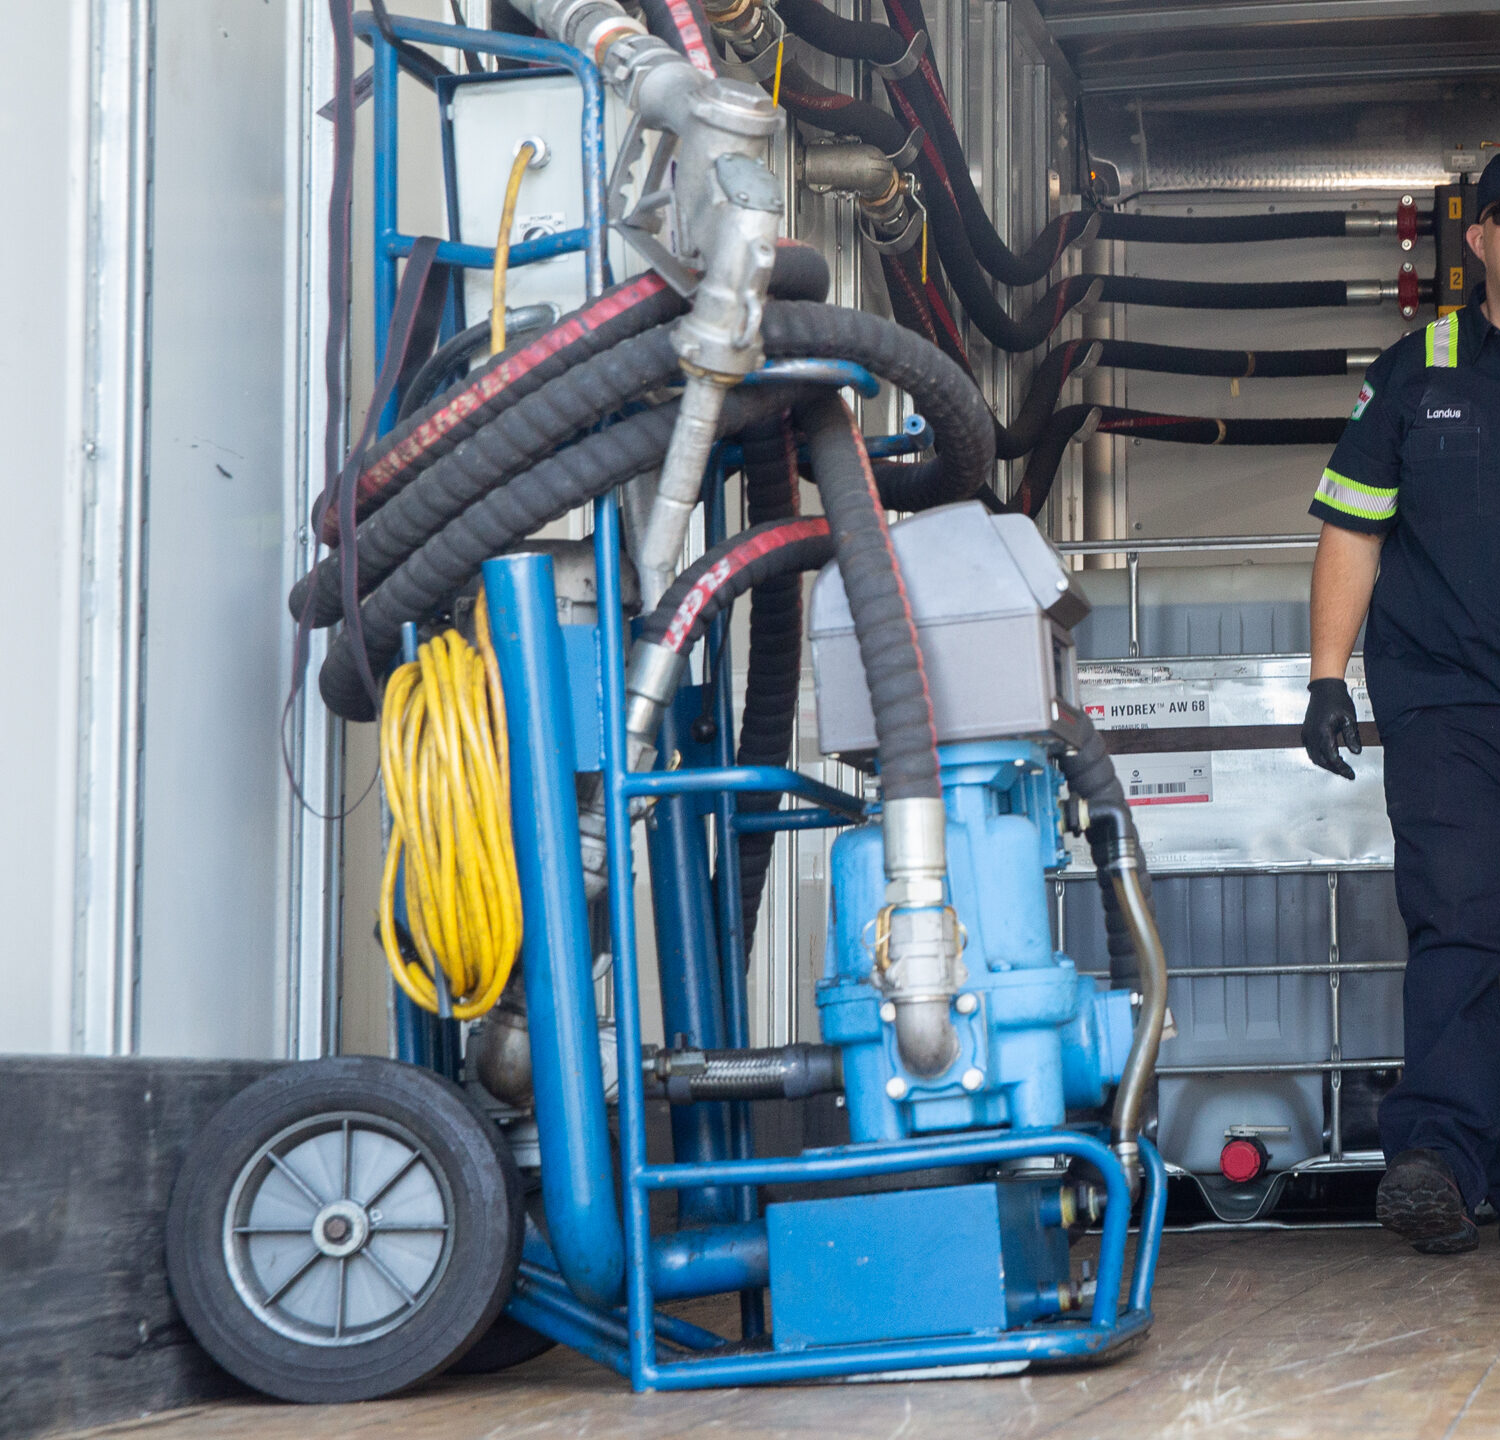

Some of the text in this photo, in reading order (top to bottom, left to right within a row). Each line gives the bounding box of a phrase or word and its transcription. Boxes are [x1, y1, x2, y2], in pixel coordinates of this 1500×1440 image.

[1452, 202, 1458, 215] 1
[1453, 272, 1460, 286] 2
[1169, 701, 1188, 713] AW
[1191, 700, 1206, 712] 68
